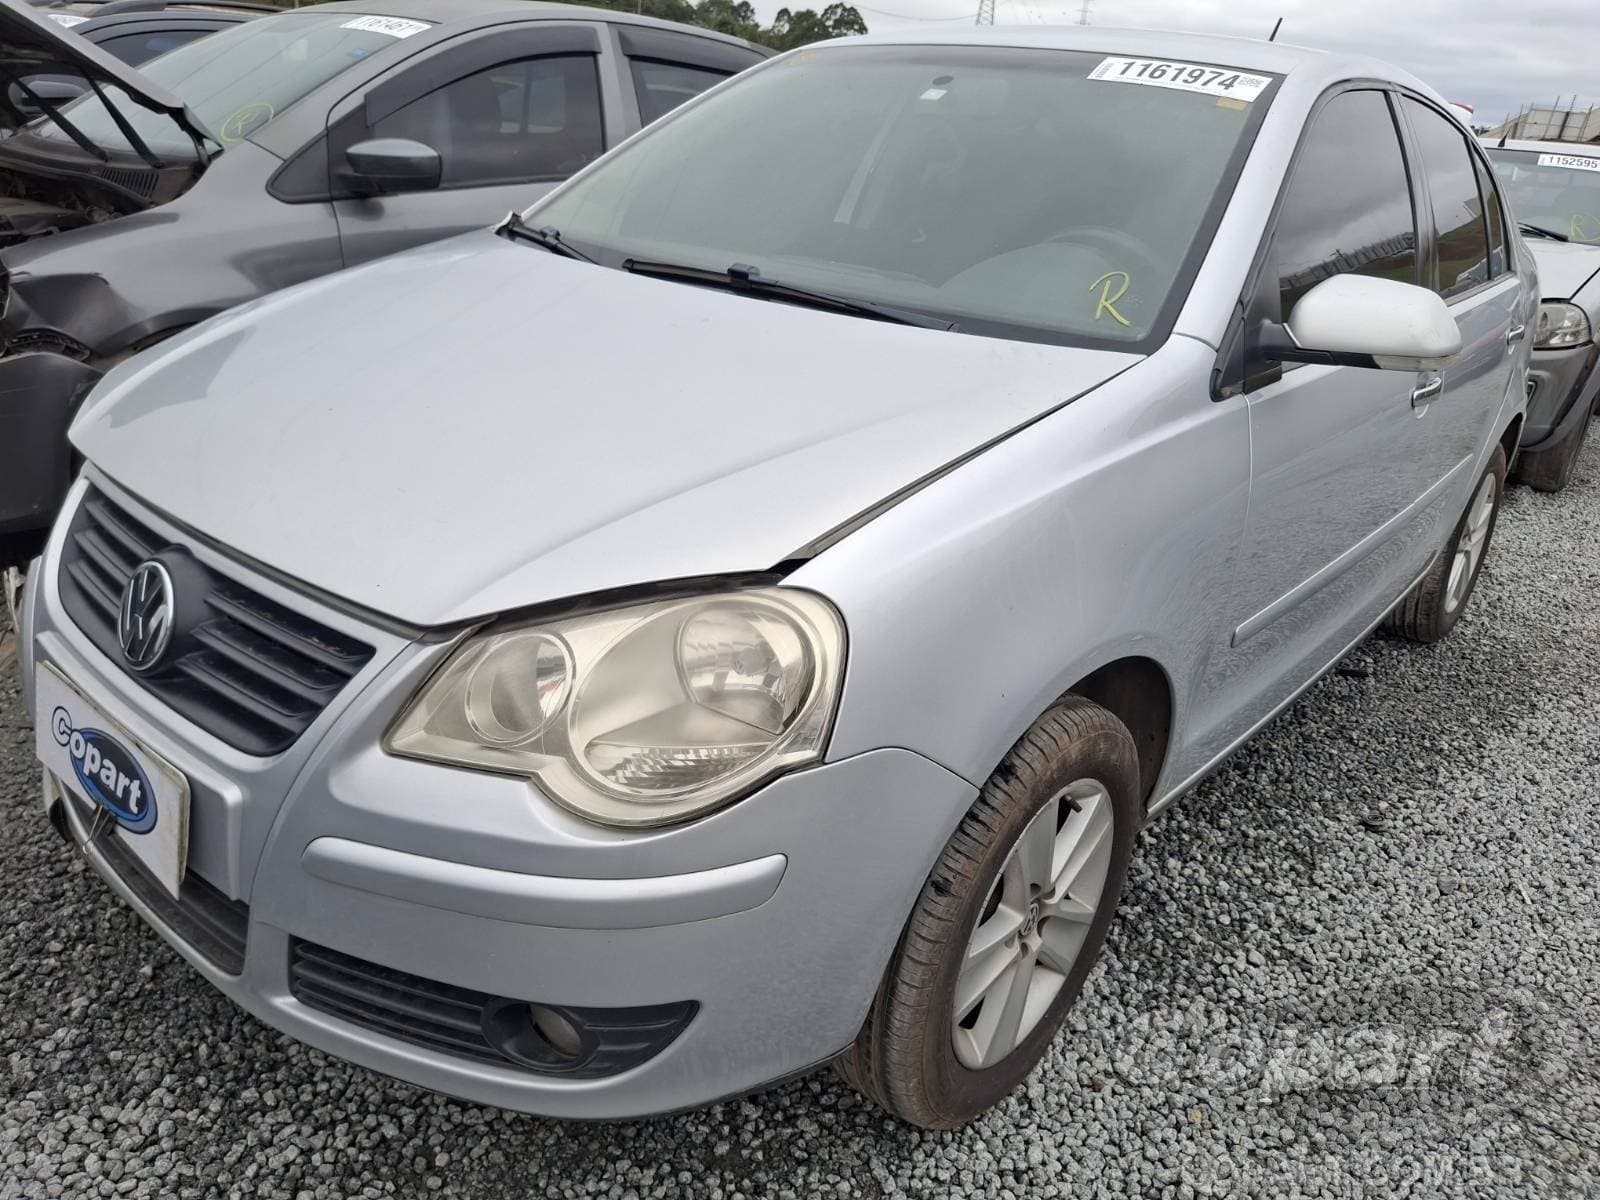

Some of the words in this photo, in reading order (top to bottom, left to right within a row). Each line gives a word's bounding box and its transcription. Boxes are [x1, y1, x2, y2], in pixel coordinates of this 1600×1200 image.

[1119, 61, 1241, 91] 1161974
[1549, 155, 1598, 168] 1152595
[1088, 271, 1132, 327] R
[51, 705, 142, 815] Copart
